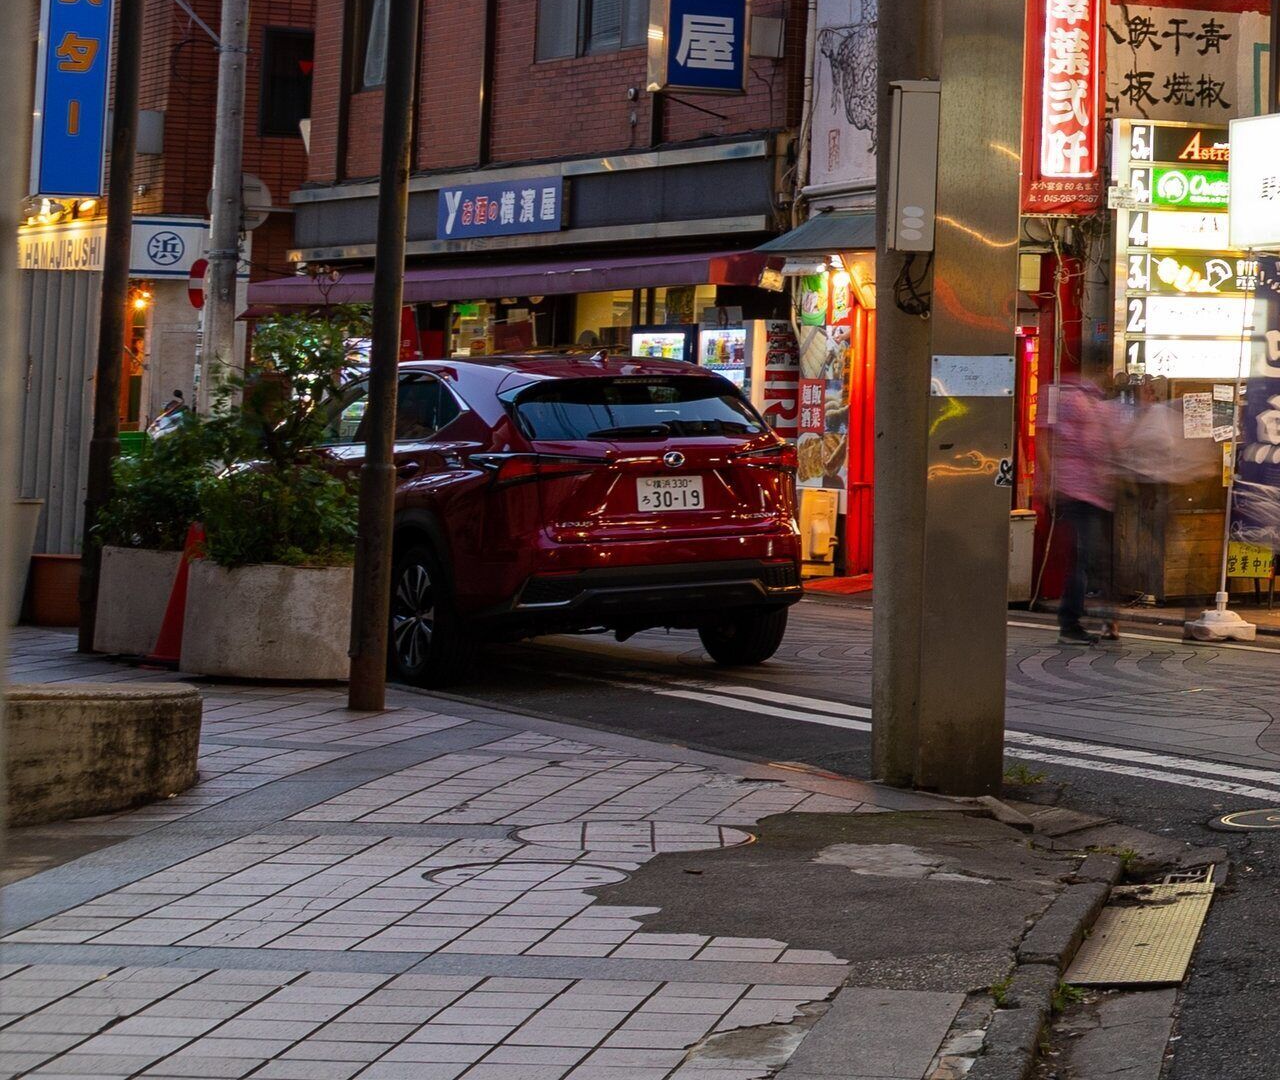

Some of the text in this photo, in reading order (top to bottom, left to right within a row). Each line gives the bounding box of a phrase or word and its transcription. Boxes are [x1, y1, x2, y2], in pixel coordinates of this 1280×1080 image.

[461, 186, 557, 226] お酒の横濱屋
[25, 236, 101, 269] HAMAJIRUSHI
[151, 237, 180, 260] 浜
[652, 489, 700, 508] 30-19
